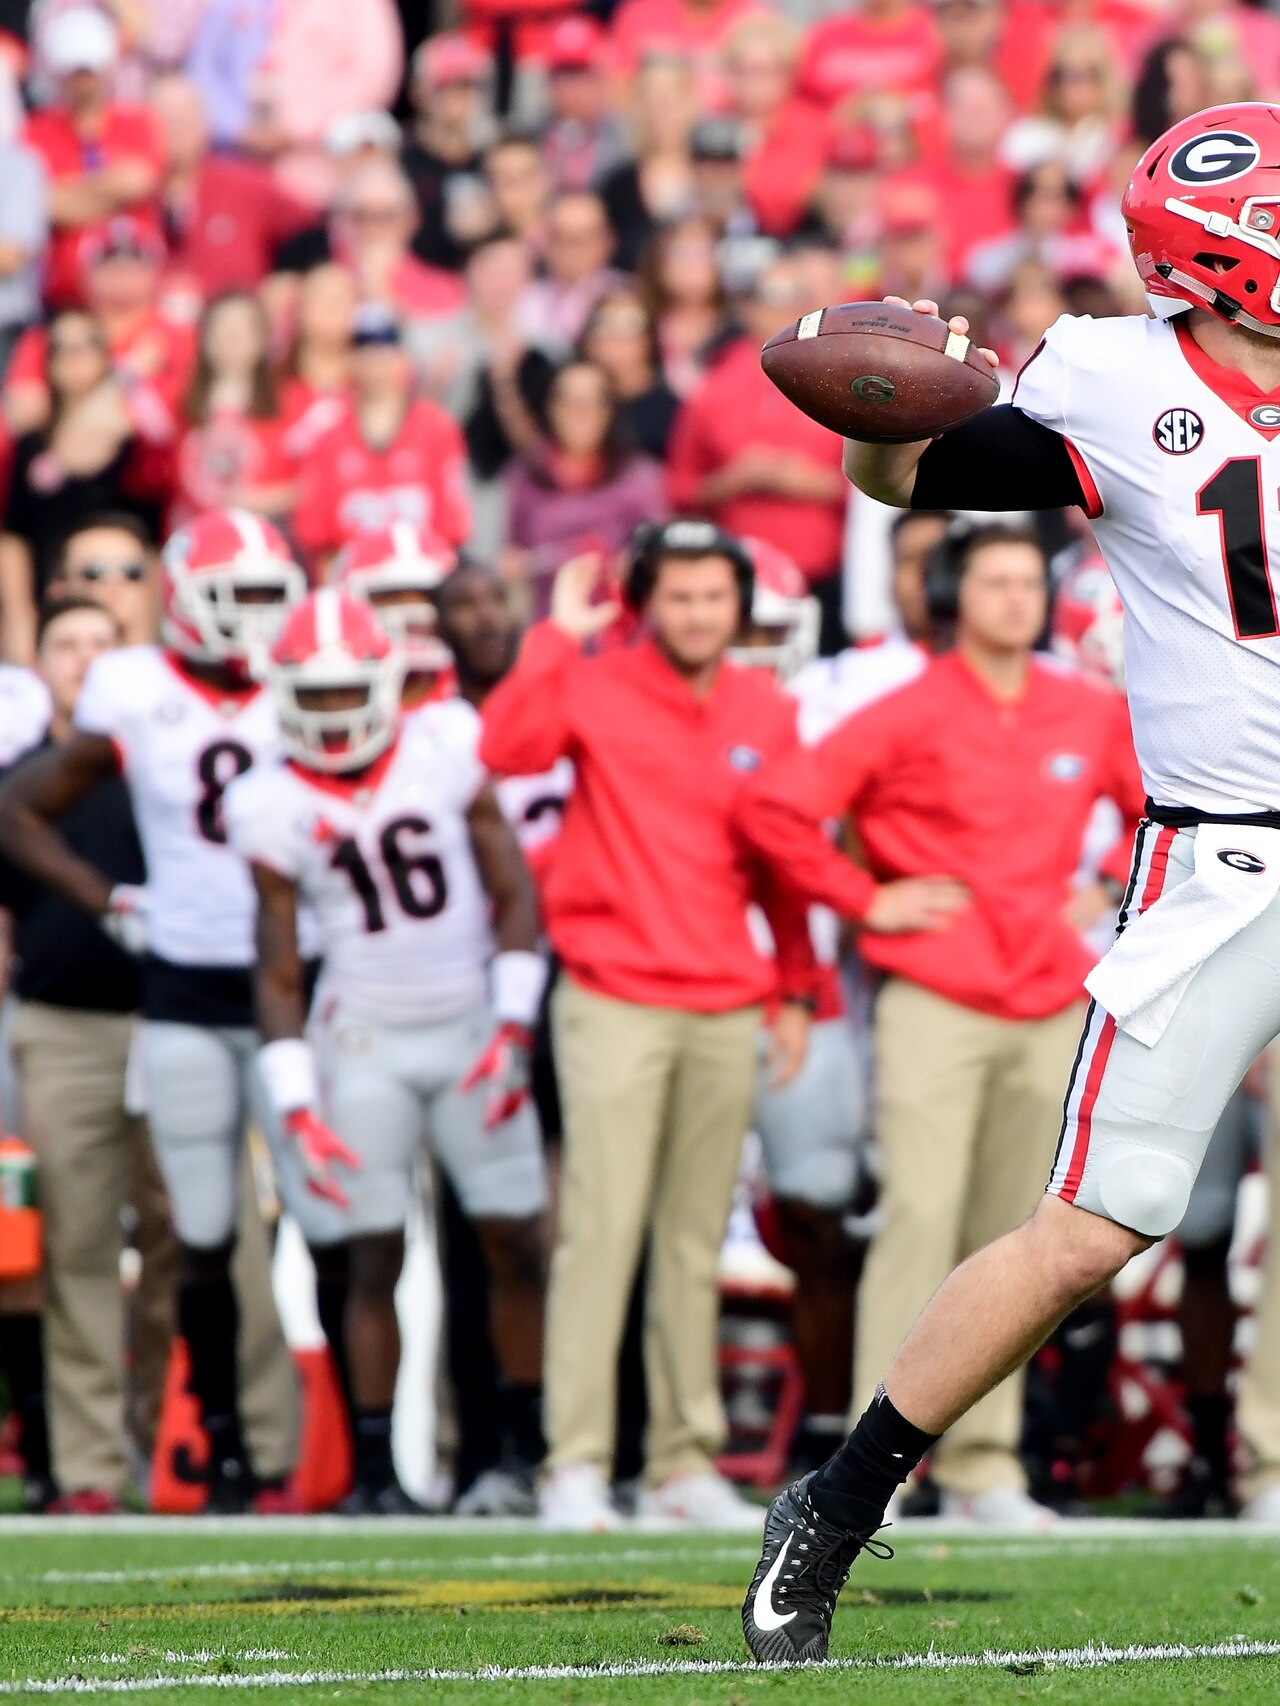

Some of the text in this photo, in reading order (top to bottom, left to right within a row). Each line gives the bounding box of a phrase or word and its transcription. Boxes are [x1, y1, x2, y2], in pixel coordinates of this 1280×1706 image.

[1169, 131, 1258, 184] G
[1156, 410, 1201, 452] SEC
[329, 817, 448, 933] 16
[1216, 850, 1266, 873] G
